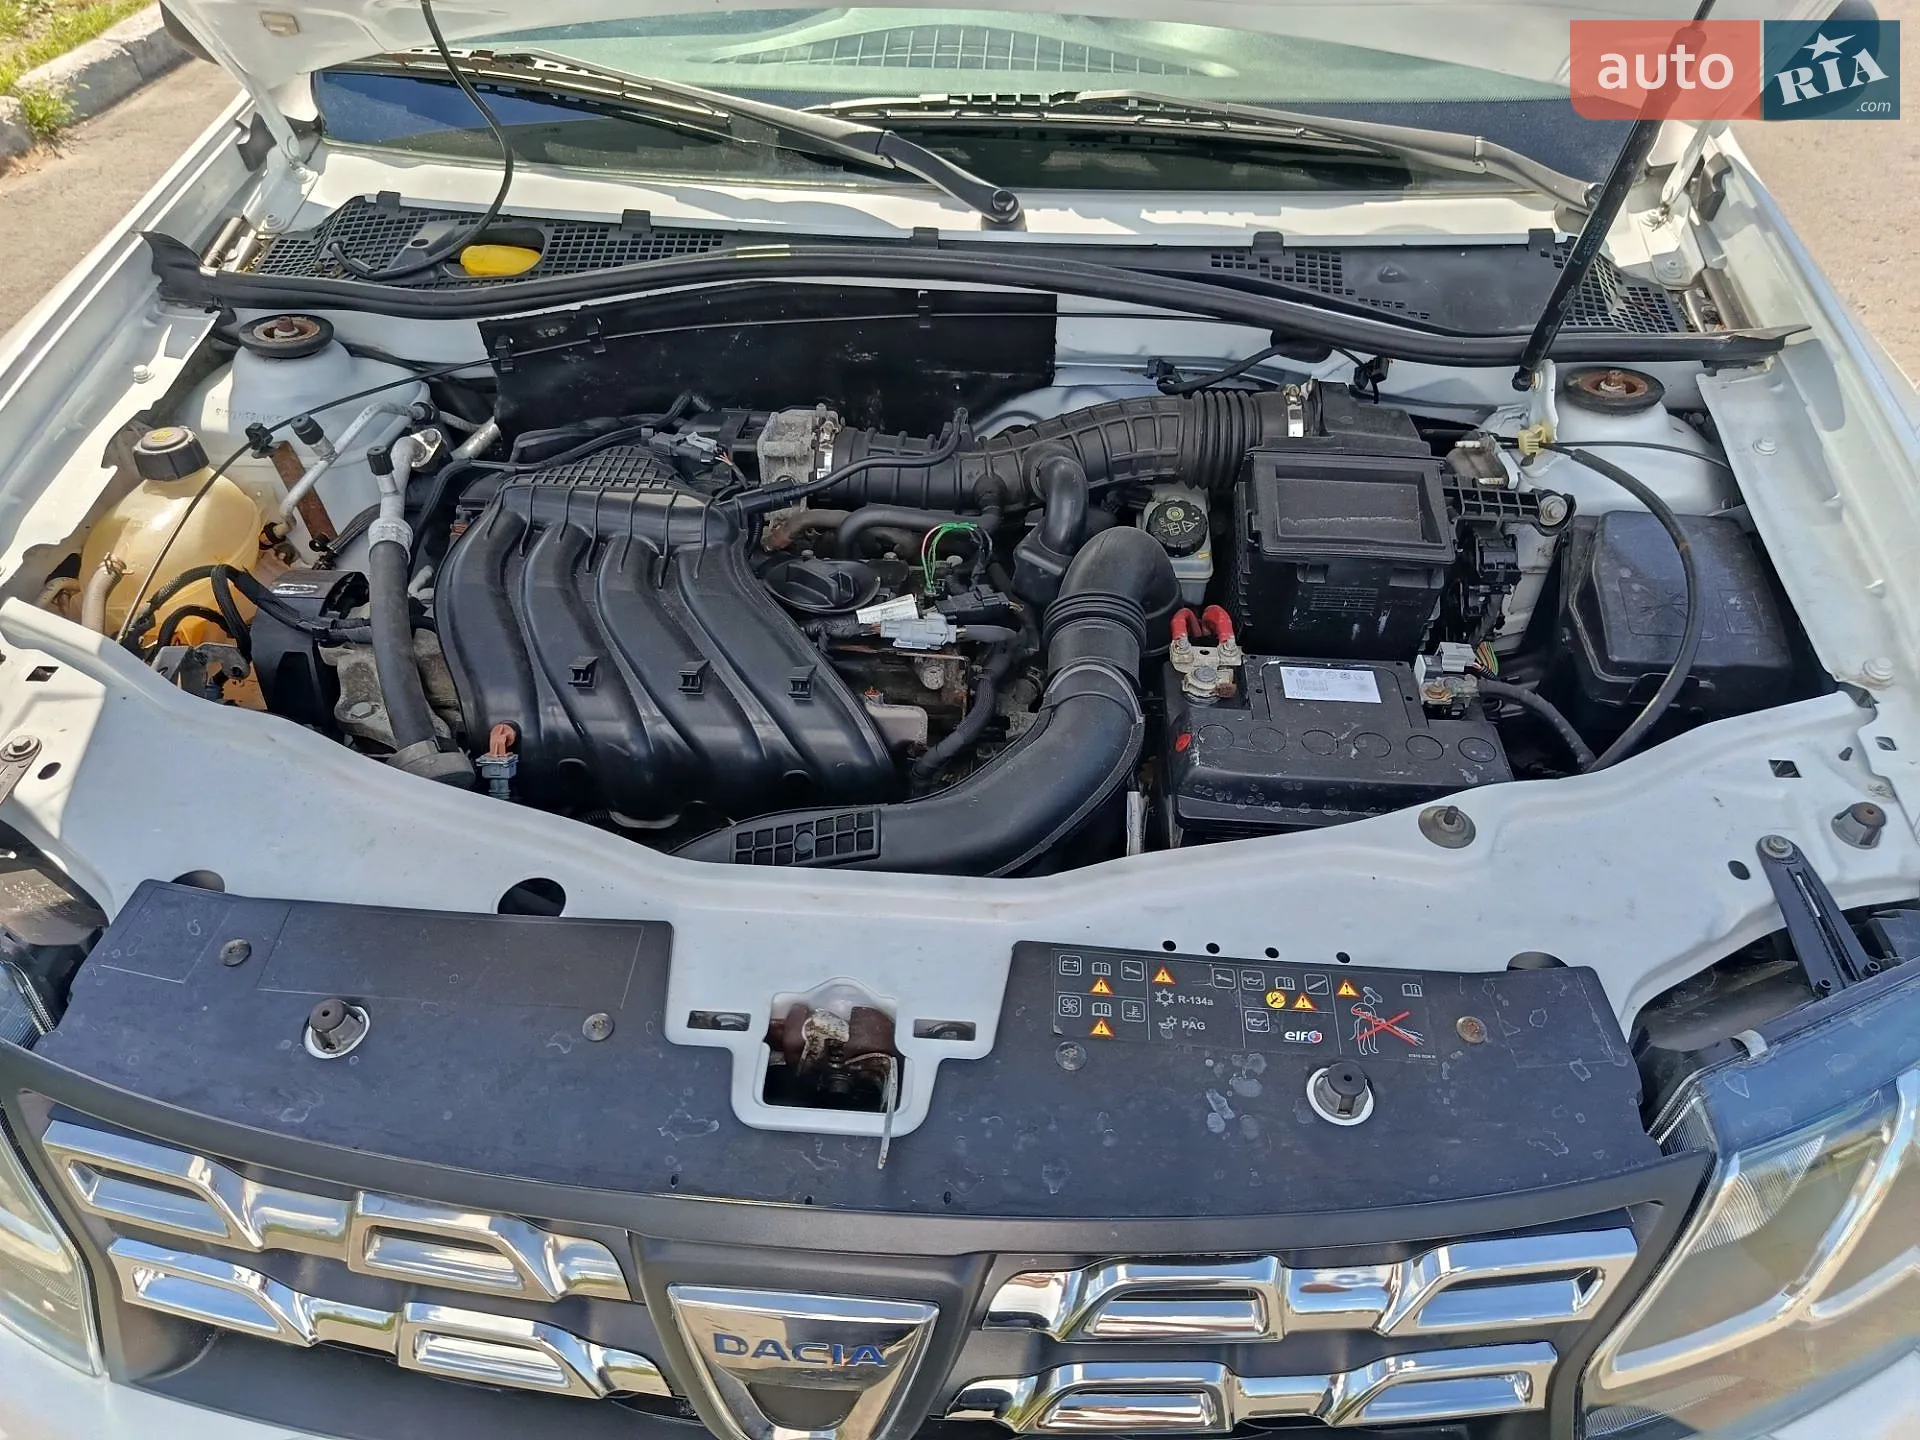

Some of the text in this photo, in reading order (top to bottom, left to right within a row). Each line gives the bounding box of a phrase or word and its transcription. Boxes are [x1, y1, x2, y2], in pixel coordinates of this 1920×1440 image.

[1177, 995, 1214, 1006] R-134a
[1181, 1020, 1206, 1030] PAG
[1284, 1030, 1309, 1041] elf
[712, 1332, 889, 1369] DACIA
